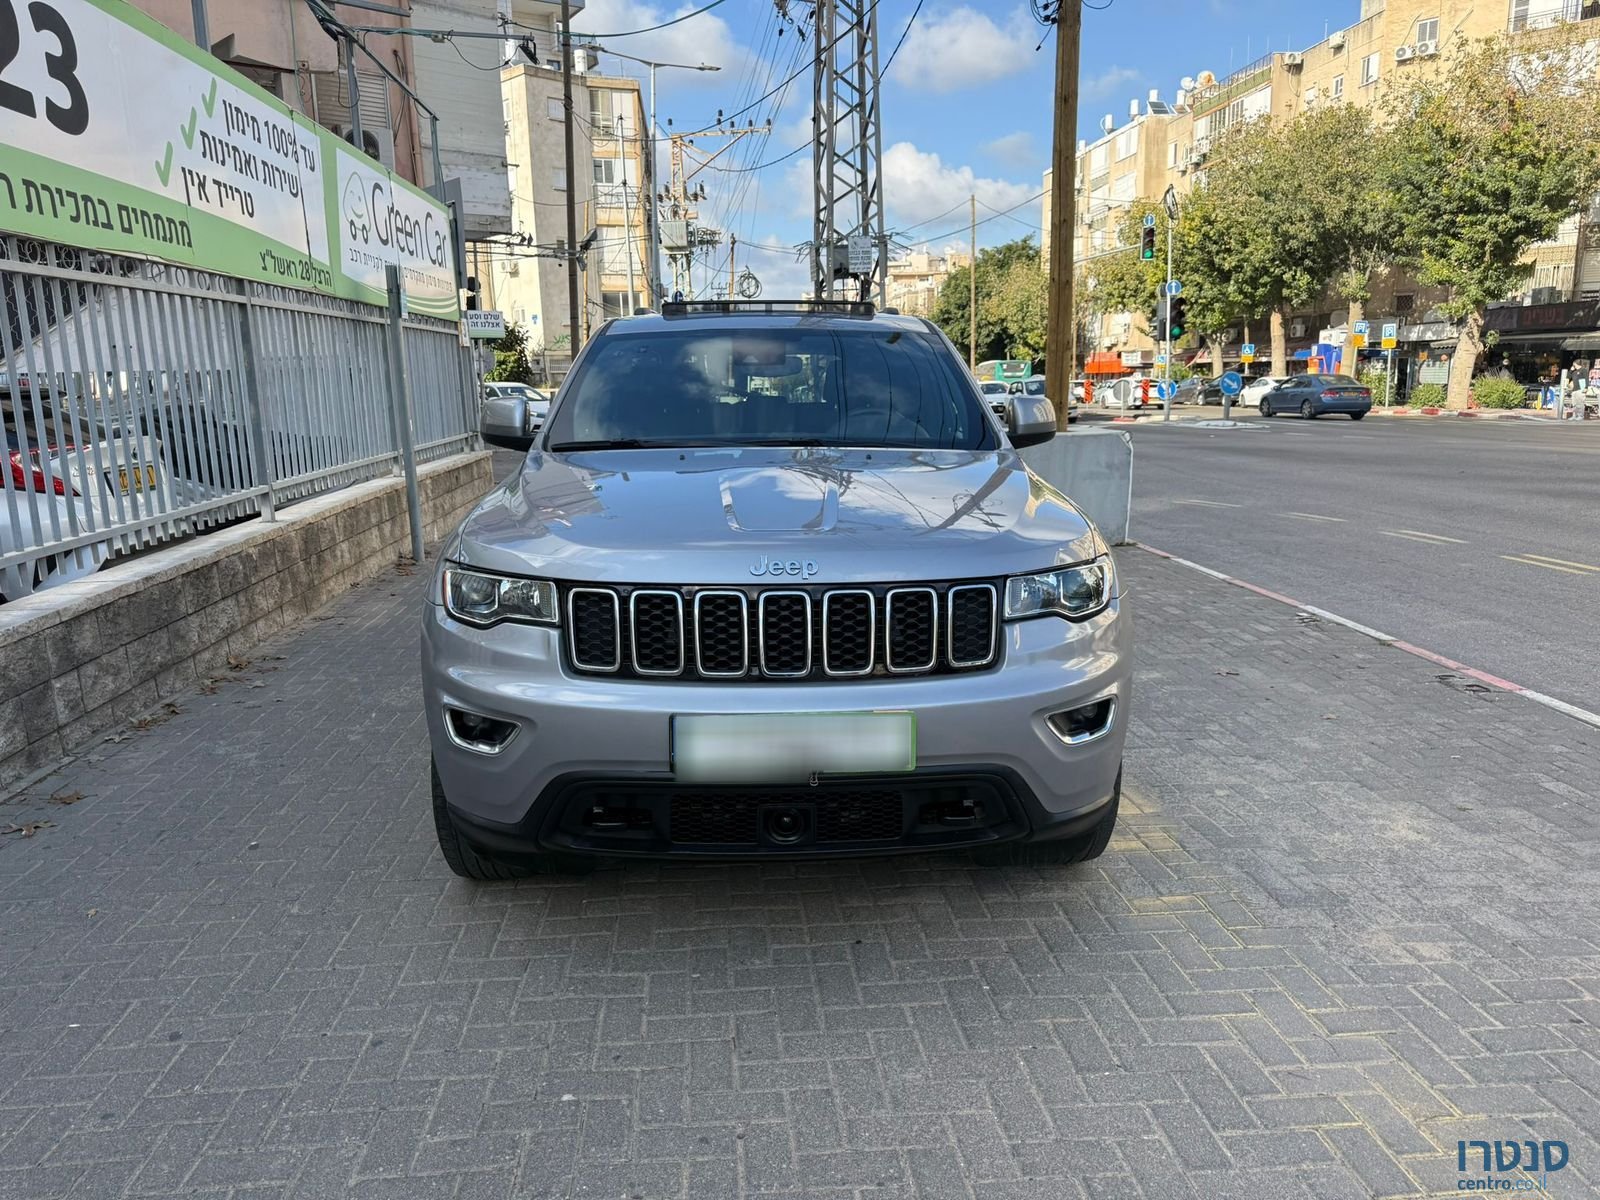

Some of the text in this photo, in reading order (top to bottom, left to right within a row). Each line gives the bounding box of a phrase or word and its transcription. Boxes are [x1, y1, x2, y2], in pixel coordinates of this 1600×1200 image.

[222, 99, 315, 172] עד 100% מימון
[199, 129, 299, 198] שירות ואמינות
[21, 178, 114, 230] במכירת
[181, 166, 254, 218] טרייד אין
[117, 203, 192, 248] מתמחים
[372, 182, 447, 269] Green Car
[298, 259, 311, 281] 28
[311, 262, 332, 287] הרצל
[349, 248, 362, 264] רכב
[750, 554, 819, 580] Jeep
